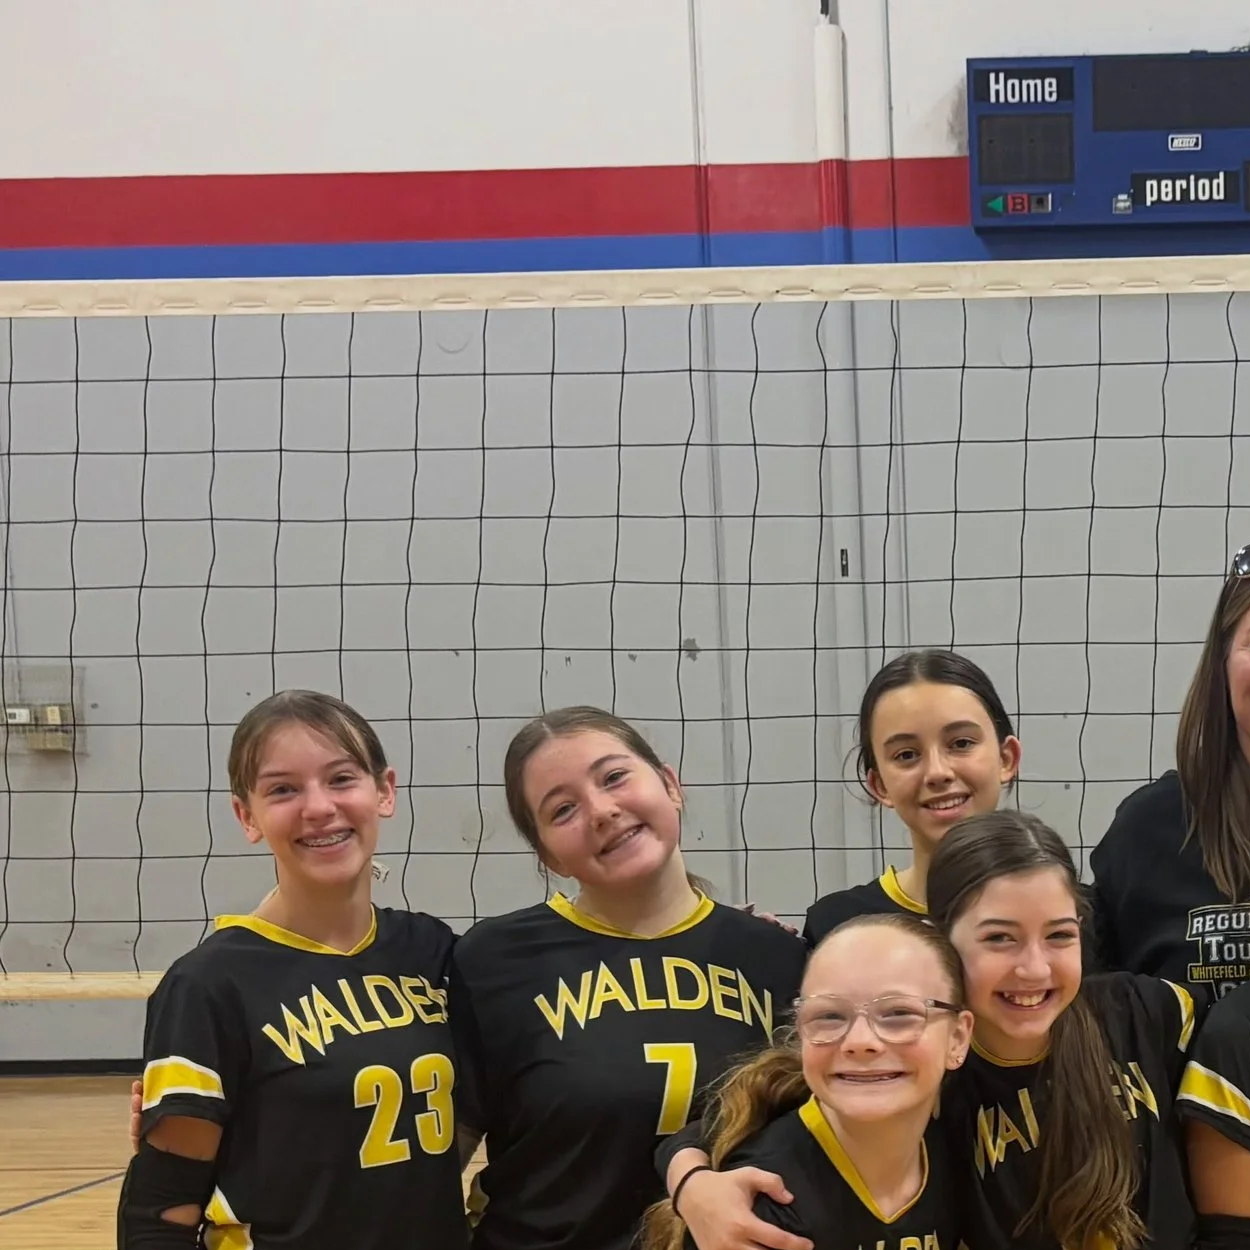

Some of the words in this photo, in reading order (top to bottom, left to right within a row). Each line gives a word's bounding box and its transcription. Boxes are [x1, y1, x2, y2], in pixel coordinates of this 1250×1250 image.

[989, 72, 1058, 104] Home
[1145, 171, 1225, 207] period
[534, 955, 774, 1048] WALDEN
[1191, 965, 1247, 980] WHITEFIELD
[353, 1052, 455, 1169] 23
[643, 1042, 698, 1136] 7
